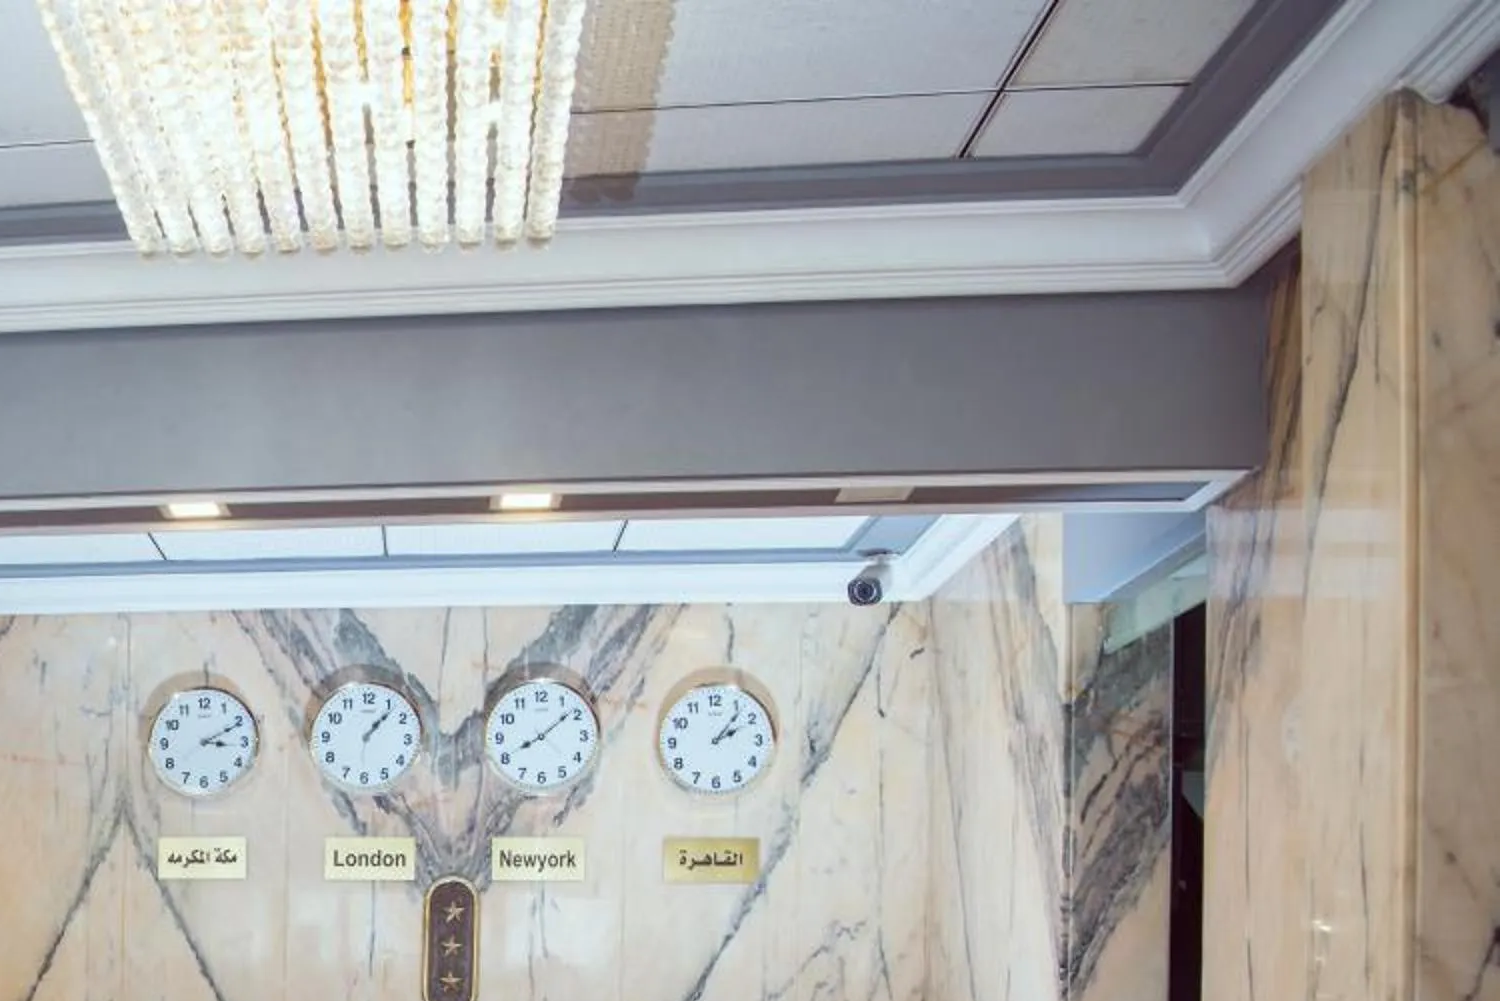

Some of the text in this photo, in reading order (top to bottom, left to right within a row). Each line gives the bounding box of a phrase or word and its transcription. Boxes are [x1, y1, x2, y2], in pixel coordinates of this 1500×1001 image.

[362, 692, 376, 704] 12
[535, 690, 549, 703] 12
[559, 695, 565, 708] 1
[708, 694, 722, 707] 12
[179, 704, 189, 716] 11
[198, 698, 211, 709] 12
[221, 702, 227, 714] 1
[342, 699, 353, 711] 11
[385, 700, 391, 710] 1
[514, 698, 525, 711] 11
[687, 702, 699, 714] 11
[734, 699, 739, 711] 1
[235, 715, 243, 727] 2
[328, 712, 343, 725] 10
[399, 712, 407, 725] 2
[500, 713, 515, 725] 10
[573, 708, 582, 721] 2
[747, 713, 757, 725] 2
[165, 719, 180, 731] 10
[672, 717, 688, 729] 10
[240, 736, 249, 748] 3
[321, 731, 331, 743] 9
[403, 733, 413, 746] 3
[495, 732, 505, 745] 9
[579, 730, 589, 743] 3
[667, 737, 677, 749] 9
[754, 733, 763, 747] 3
[160, 738, 169, 750] 9
[165, 757, 175, 769] 8
[233, 757, 243, 768] 4
[325, 751, 335, 763] 8
[396, 754, 405, 766] 4
[500, 752, 510, 765] 8
[573, 752, 582, 763] 4
[673, 757, 683, 770] 8
[747, 755, 757, 768] 4
[182, 772, 191, 784] 7
[219, 770, 229, 783] 5
[342, 766, 351, 779] 7
[380, 767, 389, 780] 5
[518, 767, 527, 780] 7
[537, 771, 547, 784] 6
[558, 765, 567, 778] 5
[692, 771, 701, 784] 7
[732, 769, 742, 783] 5
[199, 776, 209, 788] 6
[359, 772, 369, 785] 6
[711, 775, 721, 788] 6
[214, 847, 238, 864] مكة
[333, 849, 406, 867] London
[499, 849, 577, 873] Newyork
[678, 849, 743, 871] القاهرة
